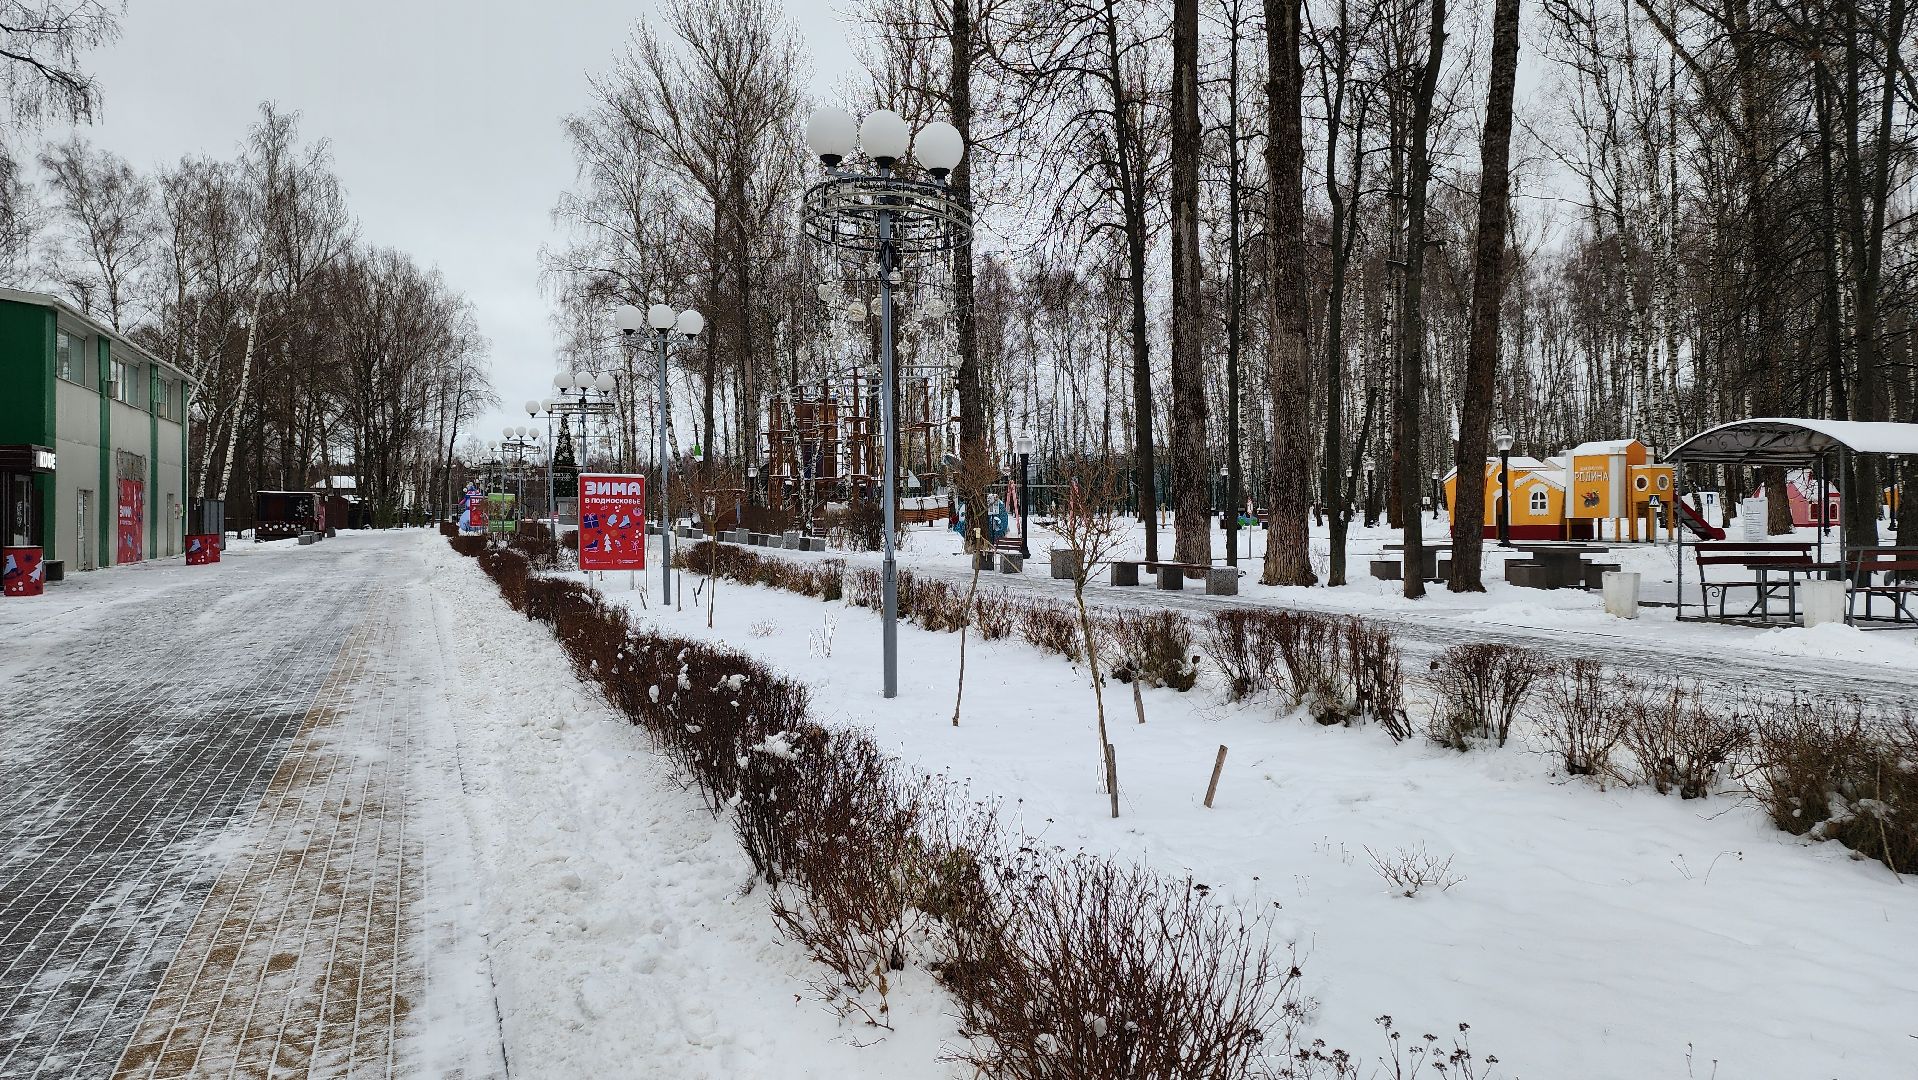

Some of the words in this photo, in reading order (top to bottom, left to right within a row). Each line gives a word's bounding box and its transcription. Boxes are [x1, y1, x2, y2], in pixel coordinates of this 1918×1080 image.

[1574, 471, 1609, 482] РОДИНА
[585, 481, 641, 495] ЗИМА
[591, 497, 641, 505] ПОДМОСКОВЬЕ
